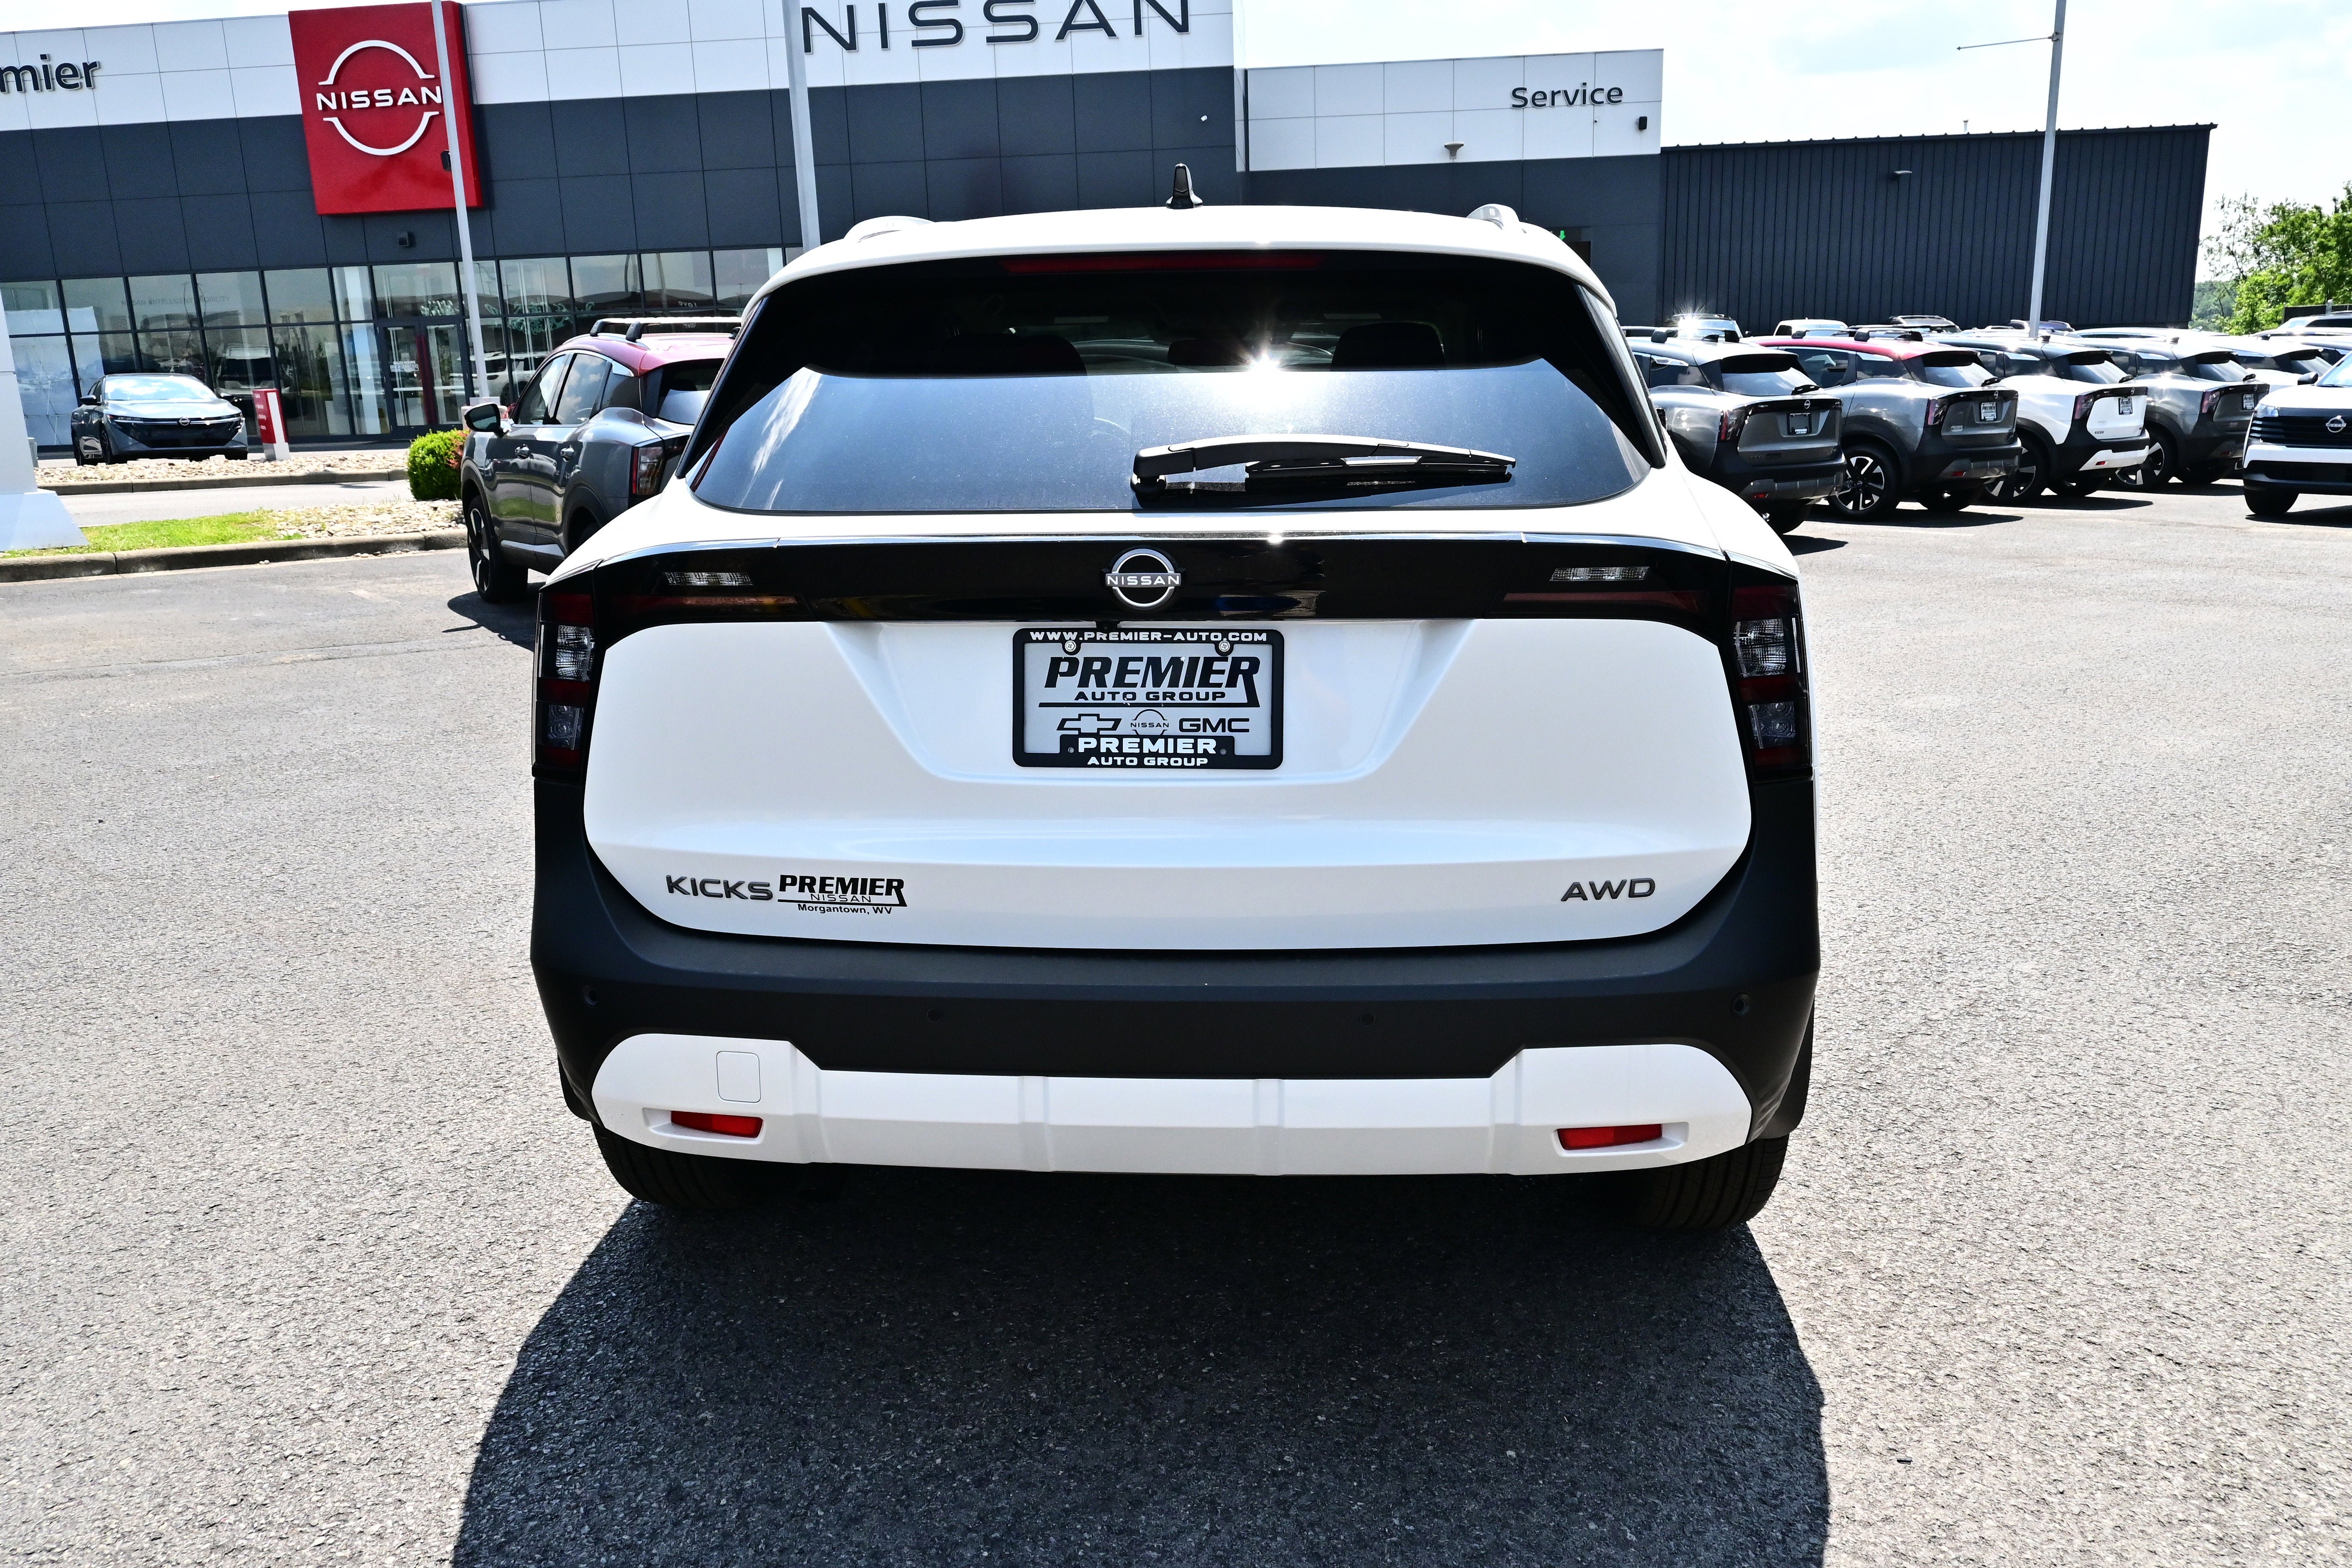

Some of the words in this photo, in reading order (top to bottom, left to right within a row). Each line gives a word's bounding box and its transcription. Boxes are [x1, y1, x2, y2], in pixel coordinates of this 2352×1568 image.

[802, 0, 1190, 54] NISSAN
[316, 86, 442, 111] NISSAN
[1511, 82, 1624, 109] Service
[1107, 575, 1179, 585] NISSAN
[1030, 632, 1267, 641] WWW.PREMIER-AUTO.COM
[1044, 656, 1260, 697] PREMIER
[1074, 691, 1136, 701] AUTO
[1146, 691, 1226, 701] GROUP
[1179, 718, 1250, 732] GMC
[1078, 737, 1217, 754] PREMIER
[1087, 757, 1138, 765] AUTO
[1144, 757, 1208, 766] GROUP
[666, 875, 773, 901] KICKS
[779, 875, 907, 904] PREMIER
[1561, 878, 1655, 901] AWD
[810, 893, 871, 903] NISSAN
[798, 904, 870, 915] Morgantown,
